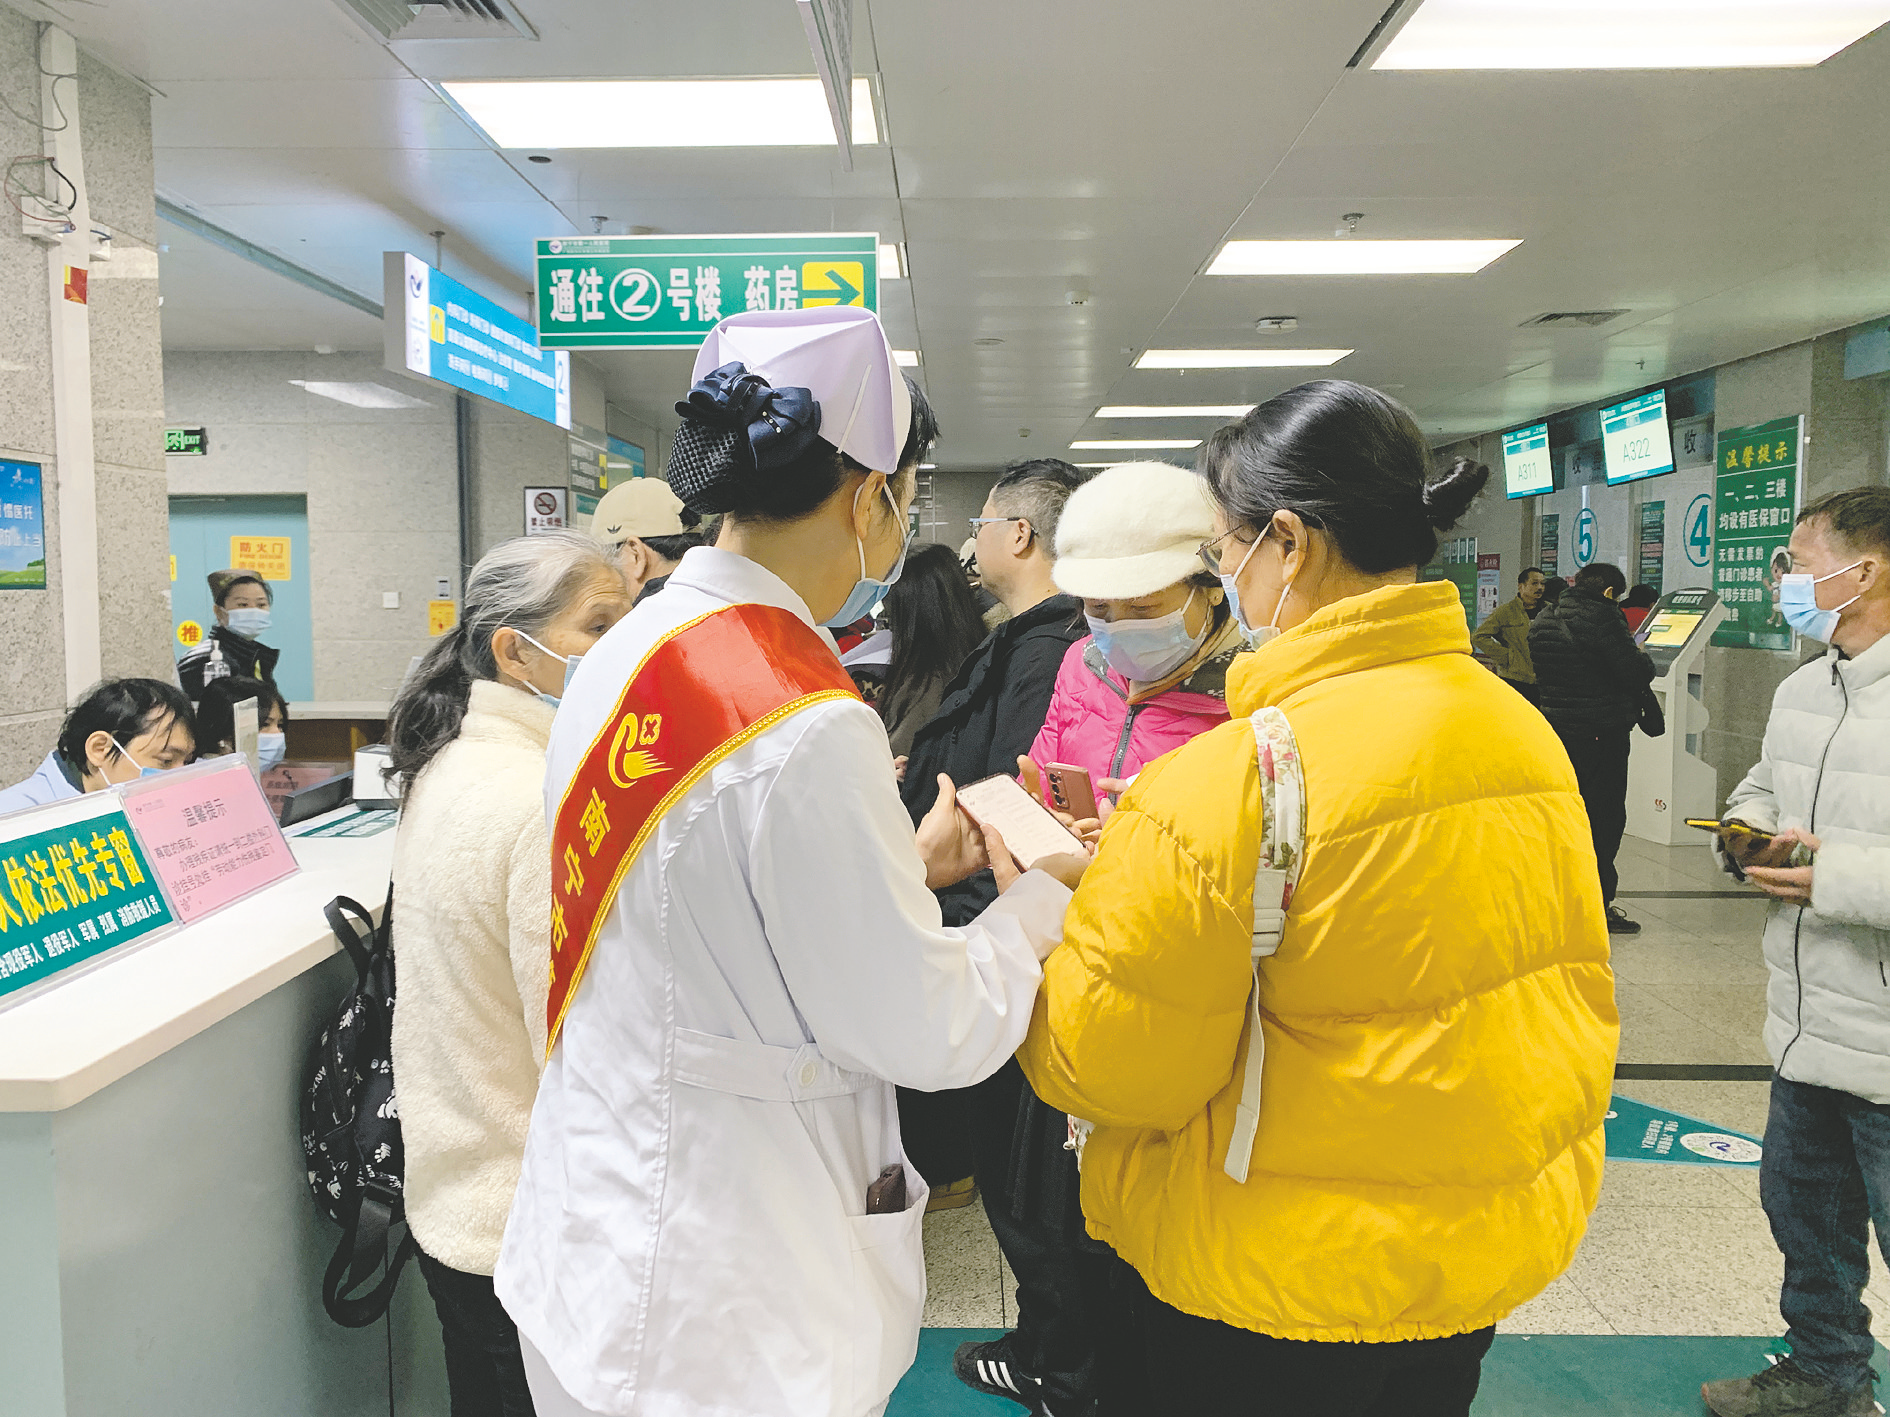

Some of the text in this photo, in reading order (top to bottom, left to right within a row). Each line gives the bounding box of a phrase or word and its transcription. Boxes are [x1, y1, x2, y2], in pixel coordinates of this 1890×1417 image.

[744, 264, 798, 310] 药房
[184, 435, 200, 445] EXIT
[1623, 437, 1651, 463] A322
[1726, 441, 1788, 469] 温馨提示
[1518, 462, 1537, 481] A311
[0, 503, 33, 520] 惕医托
[1719, 507, 1790, 530] 均设有医保窗口
[1579, 517, 1592, 562] 5
[1690, 504, 1711, 557] 4
[240, 542, 284, 553] 防火门
[181, 624, 199, 642] 推
[181, 798, 228, 828] 温馨提示
[550, 787, 611, 984] 南宁市
[42, 928, 80, 958] 退役军人
